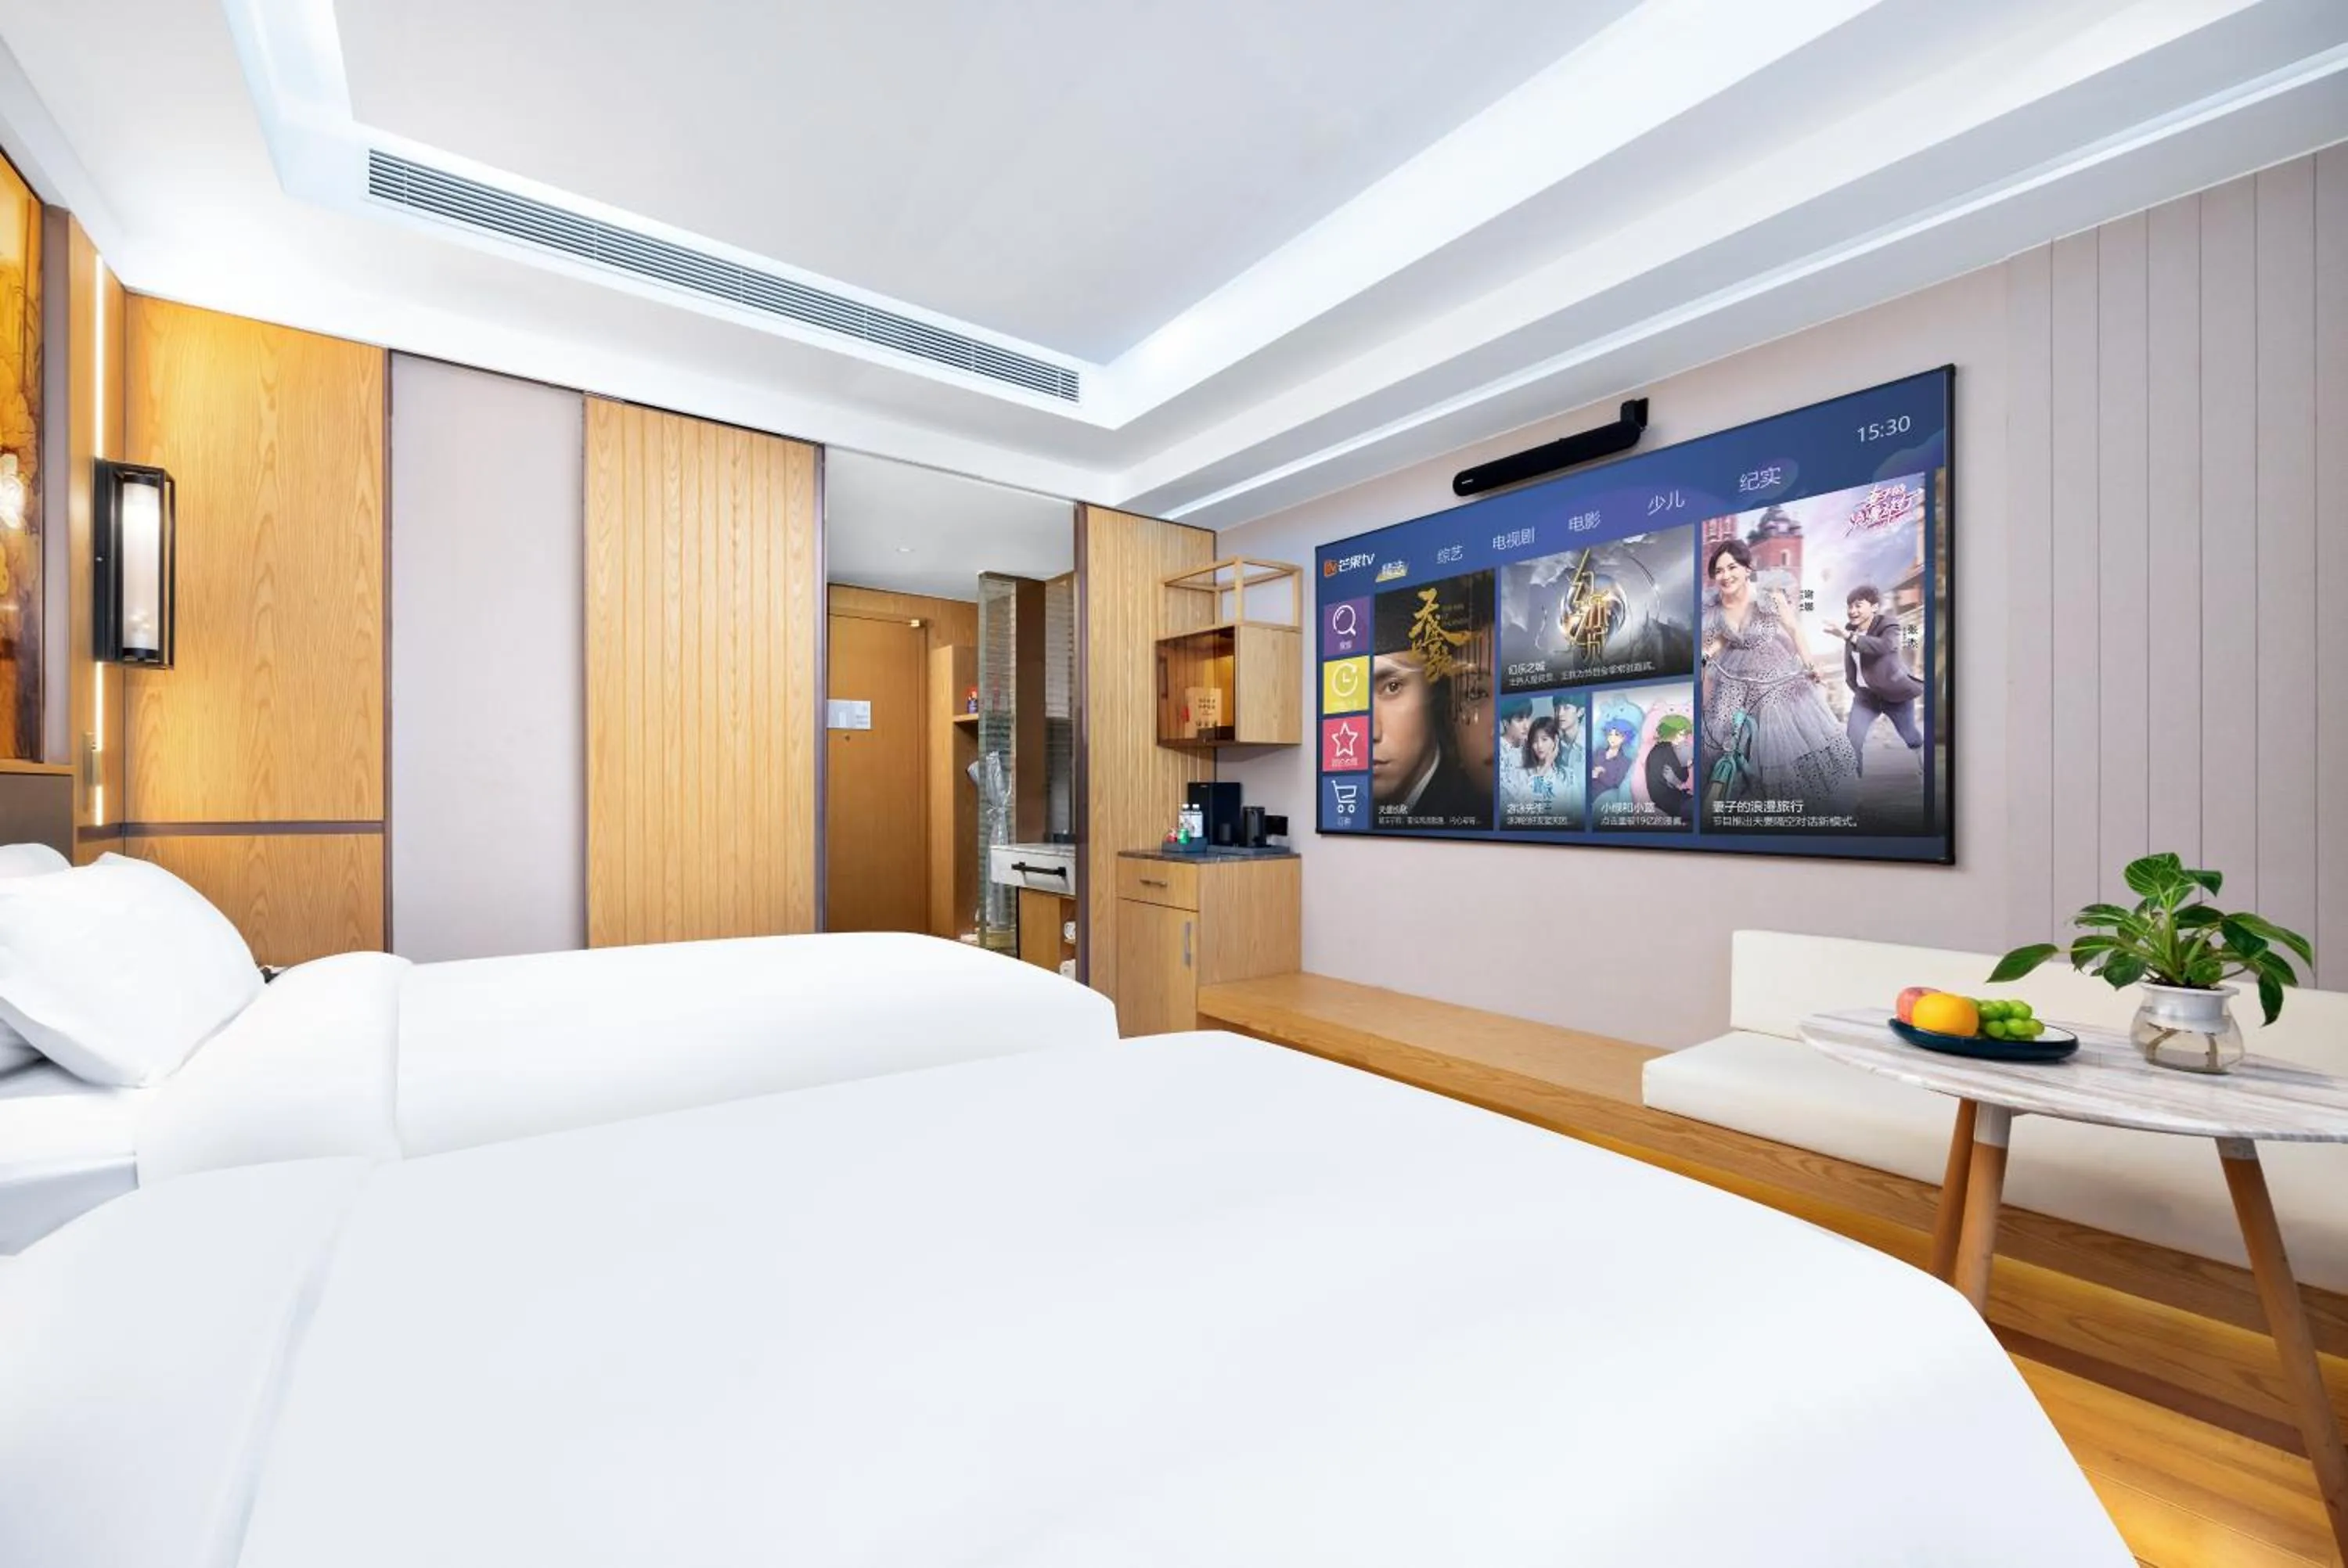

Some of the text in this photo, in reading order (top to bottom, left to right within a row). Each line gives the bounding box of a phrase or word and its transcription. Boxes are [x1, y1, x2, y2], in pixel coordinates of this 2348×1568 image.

[1857, 415, 1911, 443] 15:30
[1739, 466, 1781, 493] 纪实
[1647, 489, 1685, 516] 少儿
[1568, 510, 1601, 532] 电影
[1493, 526, 1536, 550] 电视剧
[1436, 545, 1464, 564] 综艺
[1712, 800, 1804, 813] 妻子的浪漫旅行
